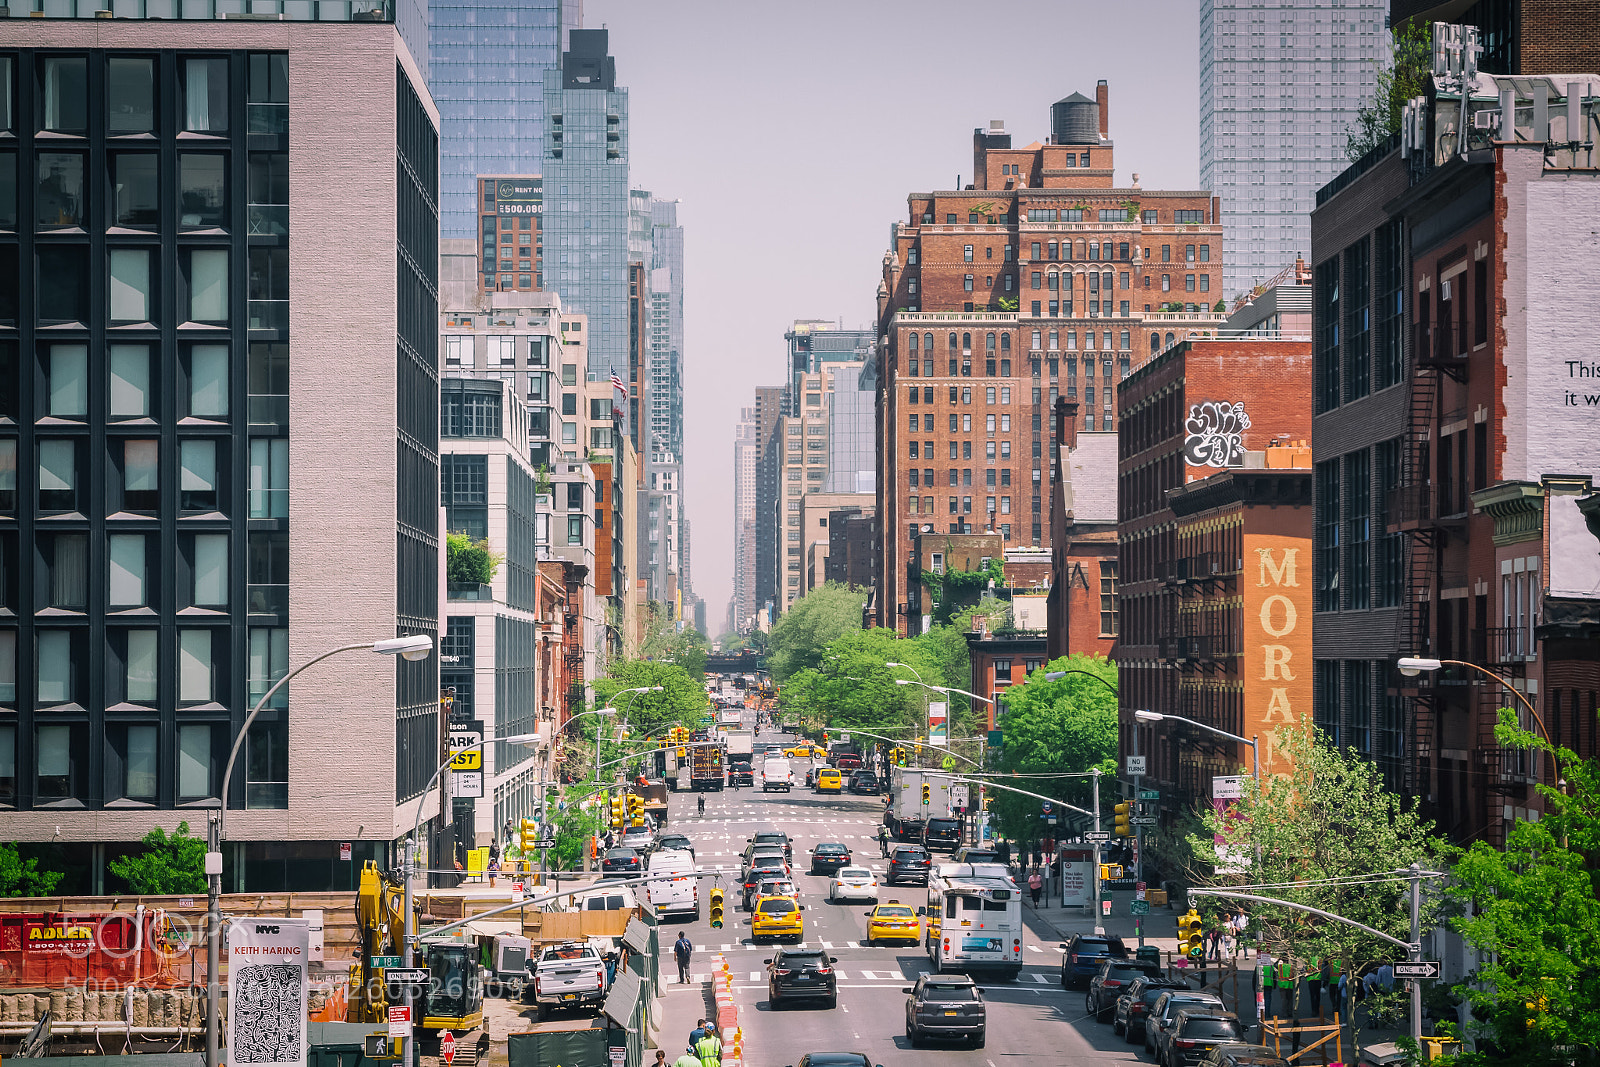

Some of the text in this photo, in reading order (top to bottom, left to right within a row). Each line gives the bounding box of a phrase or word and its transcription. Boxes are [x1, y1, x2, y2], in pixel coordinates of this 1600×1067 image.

[1565, 360, 1600, 378] This
[1565, 389, 1578, 406] it
[29, 927, 93, 940] ADLER
[255, 925, 280, 934] NYC
[234, 946, 301, 955] KEITH HARING
[372, 957, 380, 967] W
[384, 957, 393, 967] 18
[443, 1041, 455, 1054] STOP
